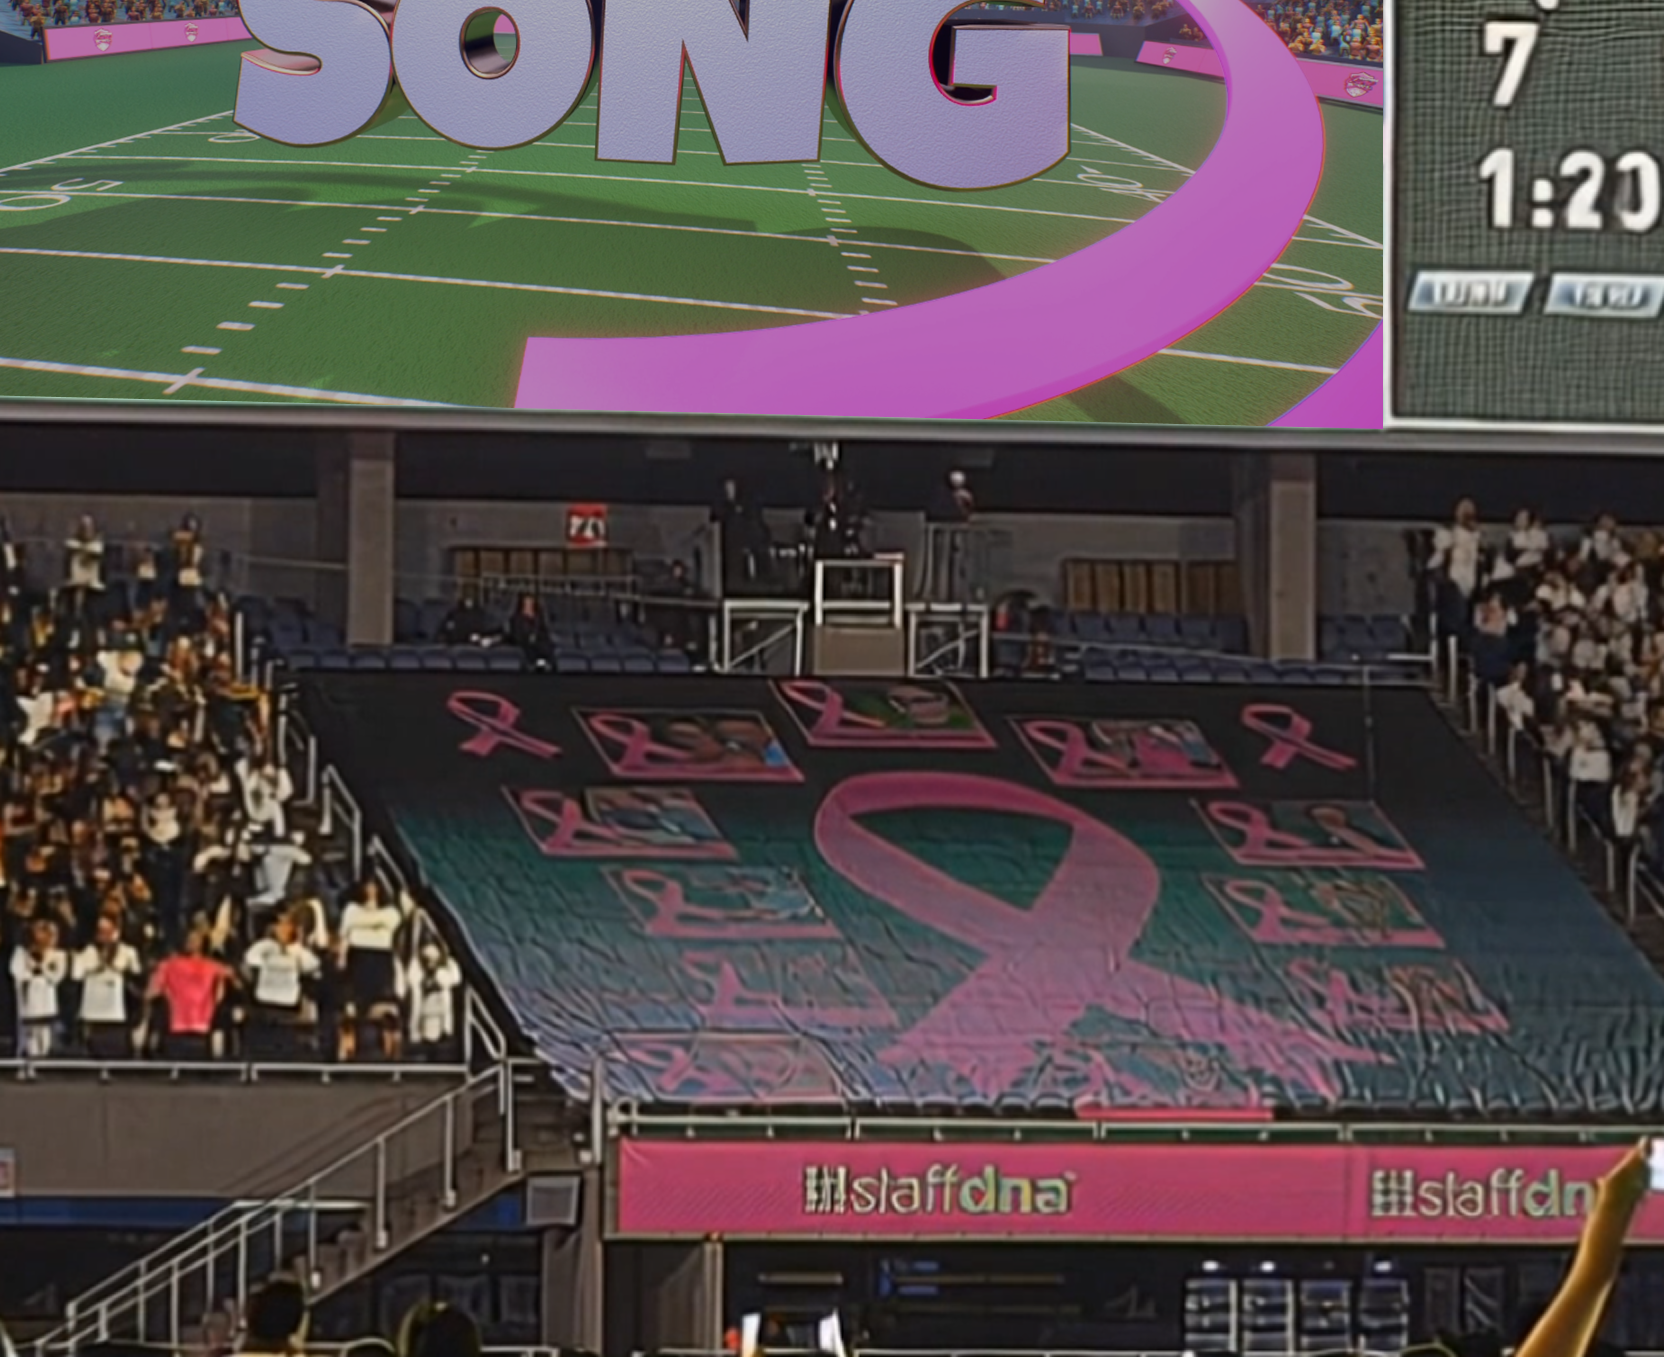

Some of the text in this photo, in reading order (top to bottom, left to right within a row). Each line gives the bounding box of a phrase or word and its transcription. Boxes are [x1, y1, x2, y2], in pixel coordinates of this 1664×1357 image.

[1484, 22, 1539, 107] 7
[1479, 147, 1661, 233] 1:20
[1418, 1168, 1599, 1217] staffdn
